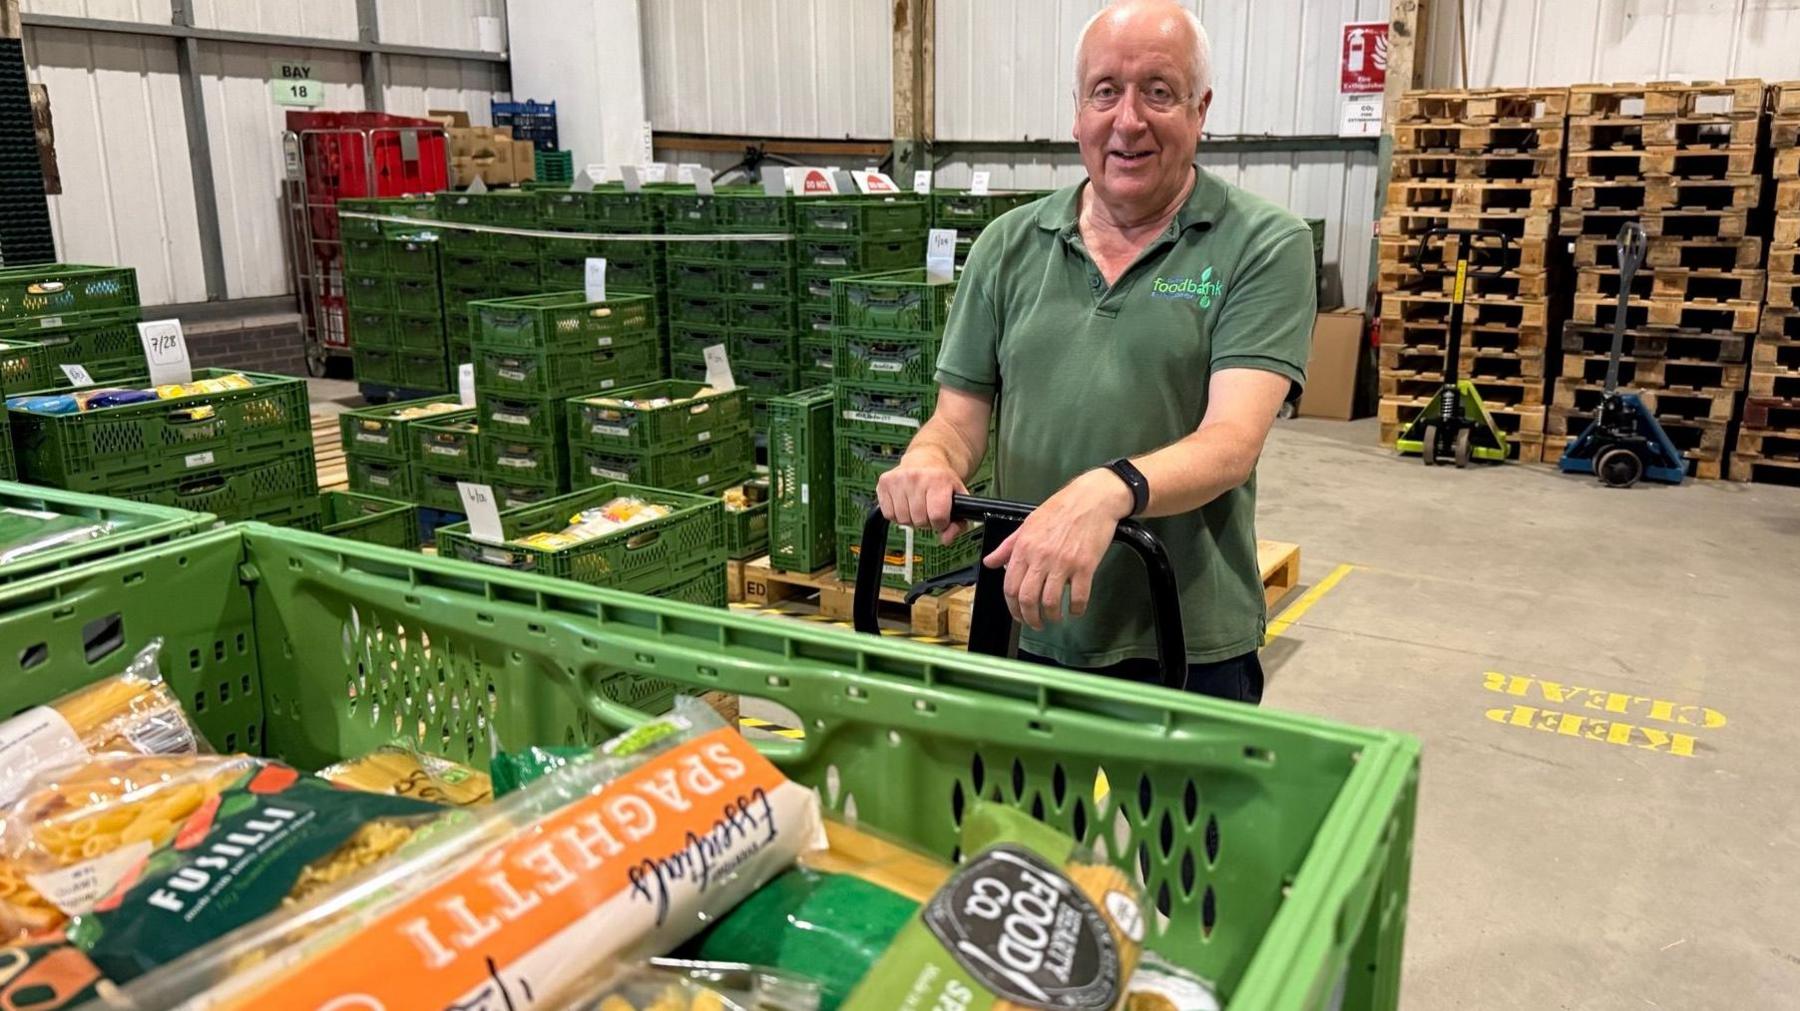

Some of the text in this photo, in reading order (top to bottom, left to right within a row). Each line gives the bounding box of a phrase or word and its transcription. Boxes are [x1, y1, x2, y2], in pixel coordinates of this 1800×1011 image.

[282, 65, 310, 78] BAY
[290, 85, 307, 97] 18
[1153, 277, 1224, 296] foodbank
[151, 335, 178, 355] 7/28
[747, 581, 766, 596] ED
[1482, 671, 1728, 729] CLEAR
[1484, 704, 1699, 758] KEEP
[147, 807, 297, 913] FUSILLI
[402, 742, 746, 969] SPAGHETTI
[628, 786, 777, 927] Essentials
[997, 871, 1060, 974] FOOD
[1043, 901, 1083, 984] HEARTY
